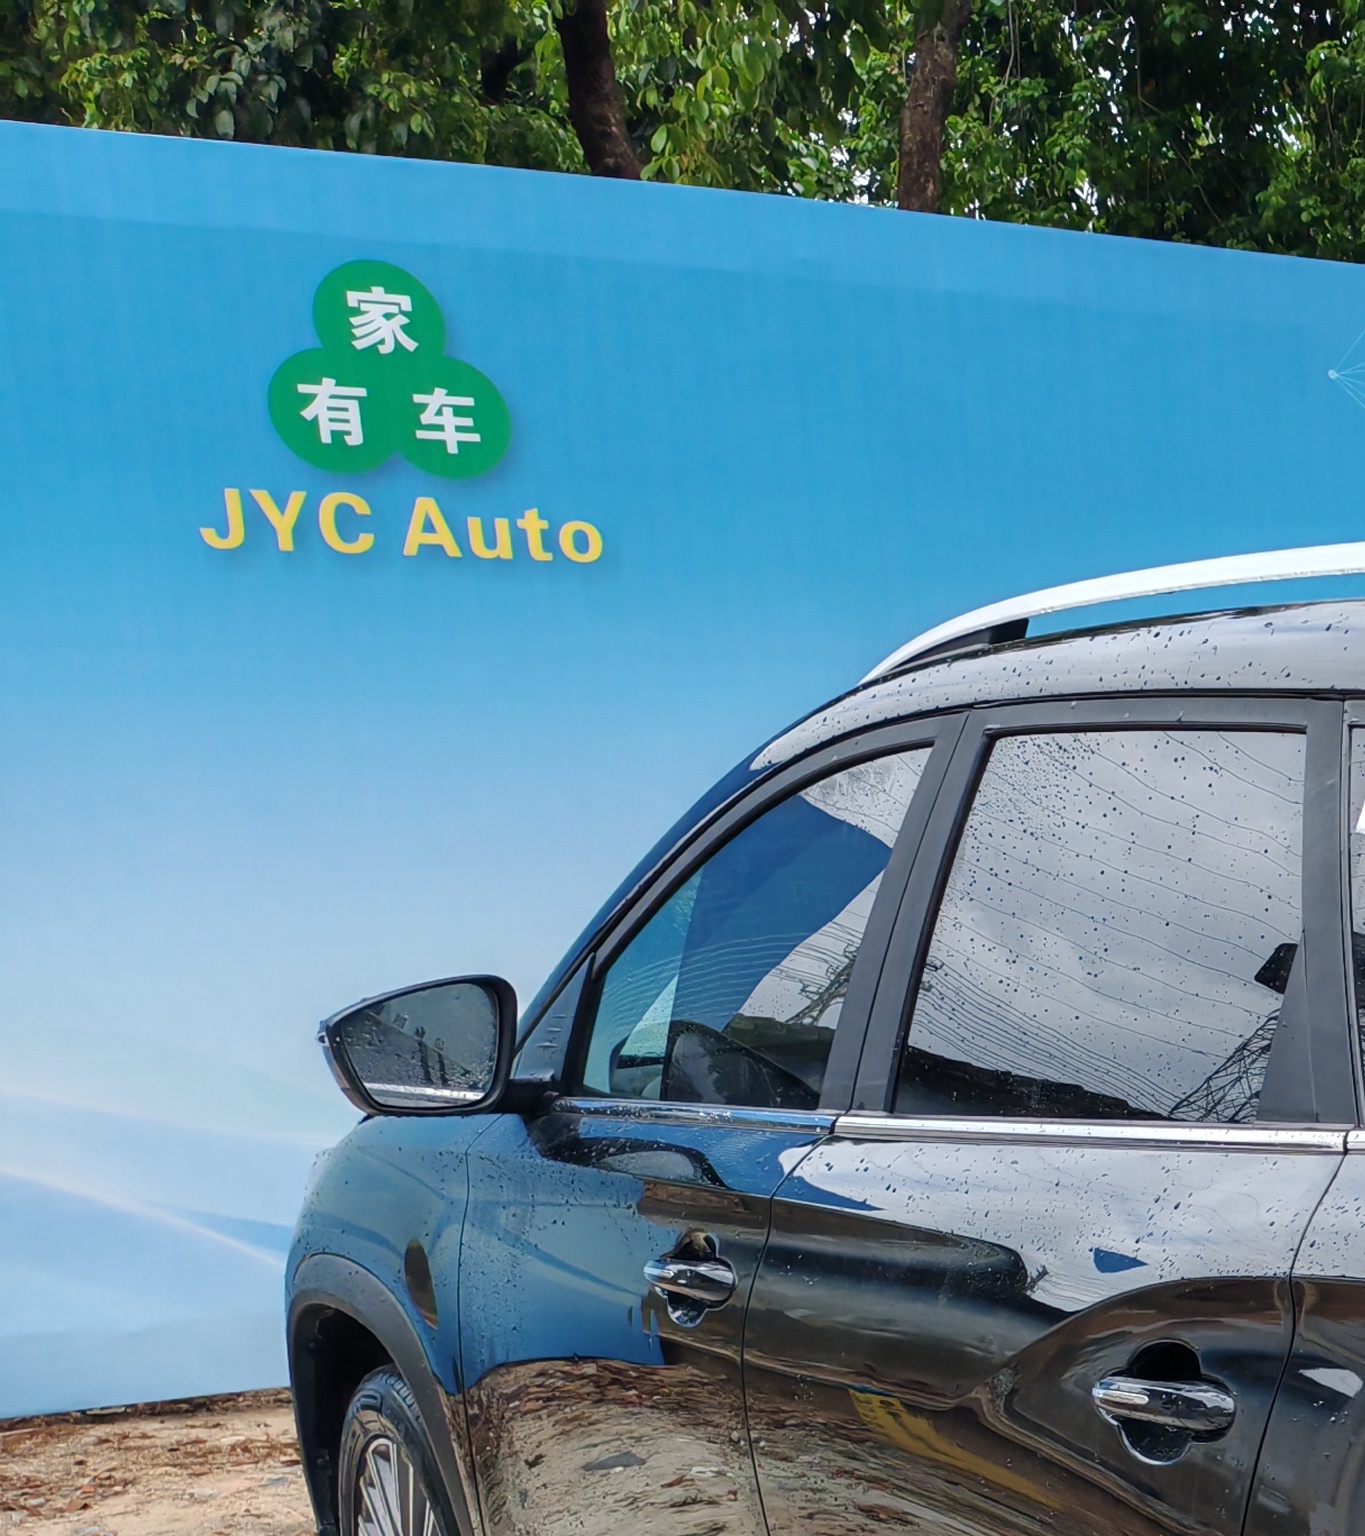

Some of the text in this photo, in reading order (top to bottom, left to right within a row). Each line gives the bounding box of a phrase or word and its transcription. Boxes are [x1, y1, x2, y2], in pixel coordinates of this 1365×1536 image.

[346, 286, 419, 354] 家
[199, 487, 604, 564] JYC Auto
